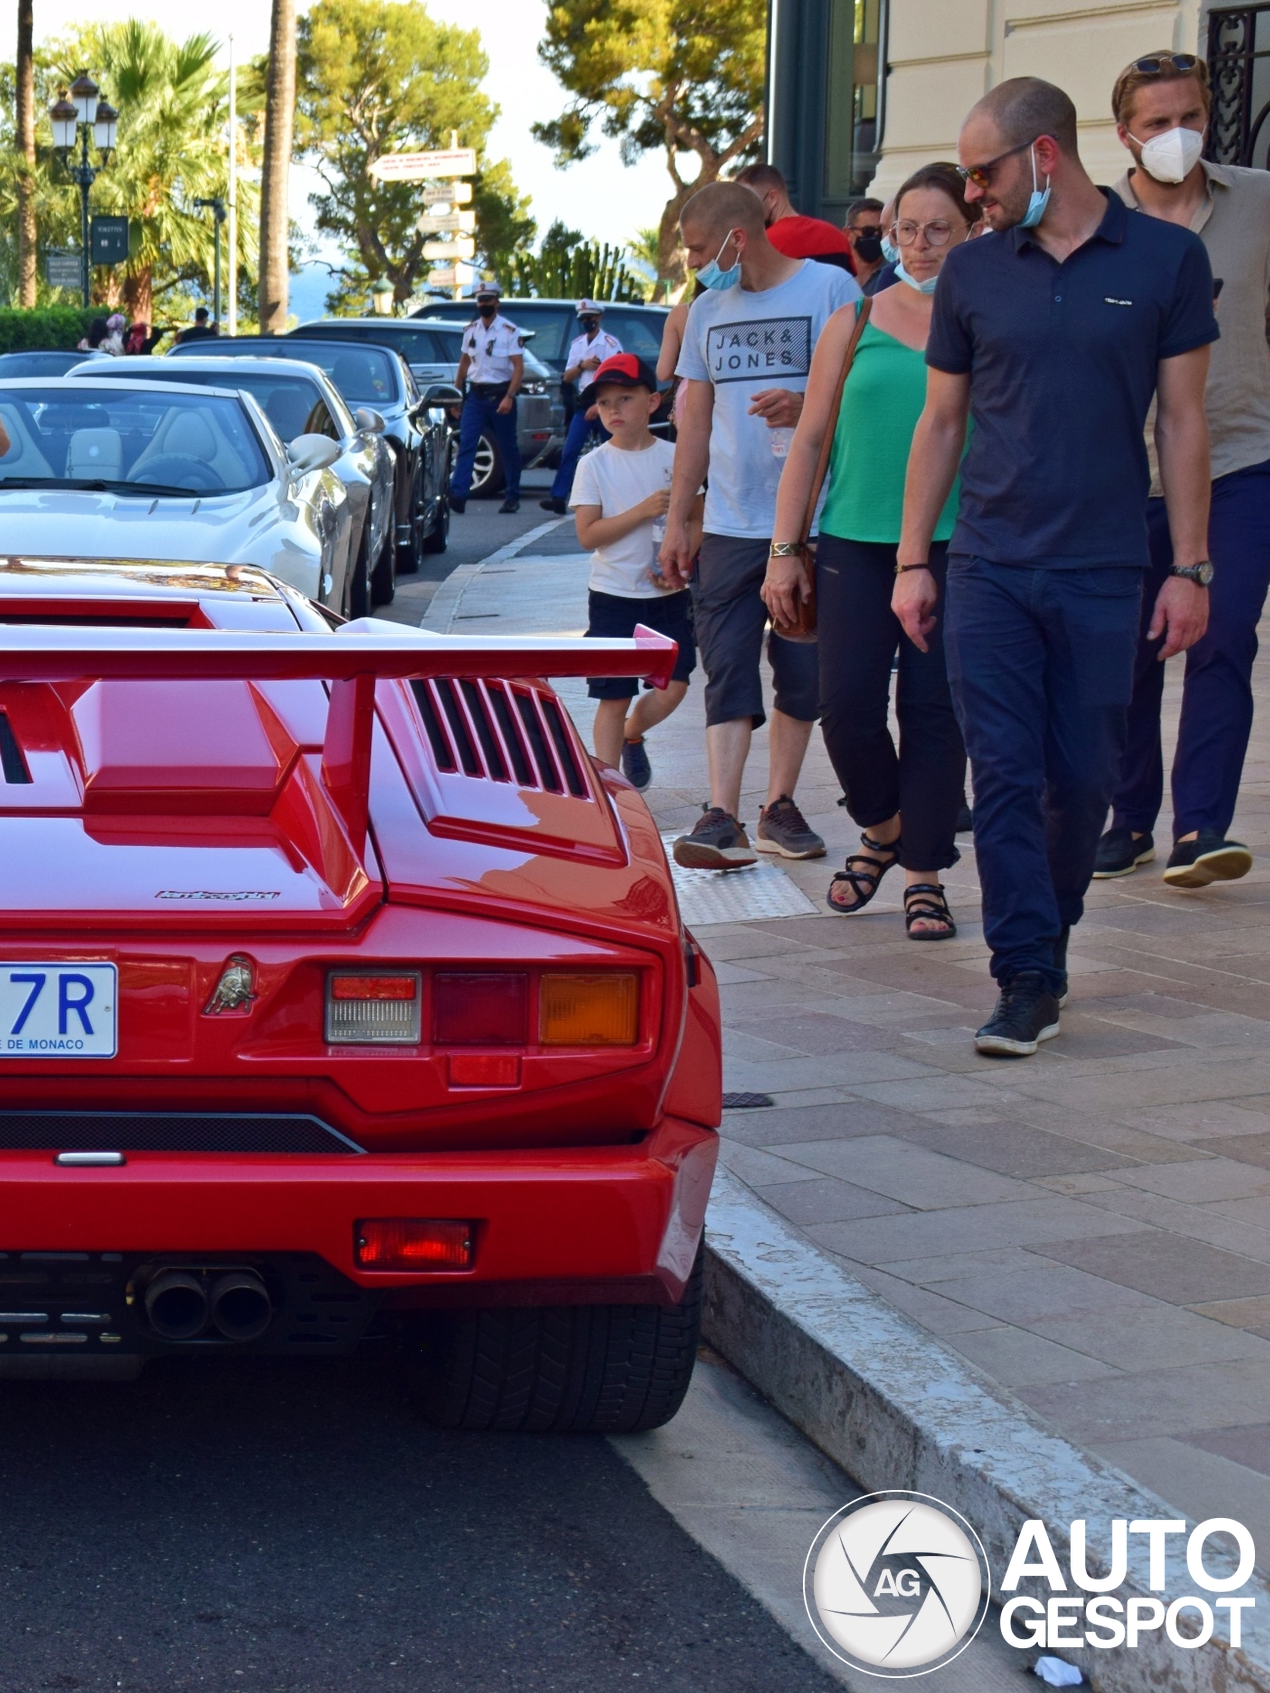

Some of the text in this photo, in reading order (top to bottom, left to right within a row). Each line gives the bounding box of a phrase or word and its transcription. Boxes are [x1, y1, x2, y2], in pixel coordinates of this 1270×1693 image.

[715, 350, 793, 371] JONES
[7, 1039, 24, 1049] DE
[29, 1039, 84, 1049] MONACO
